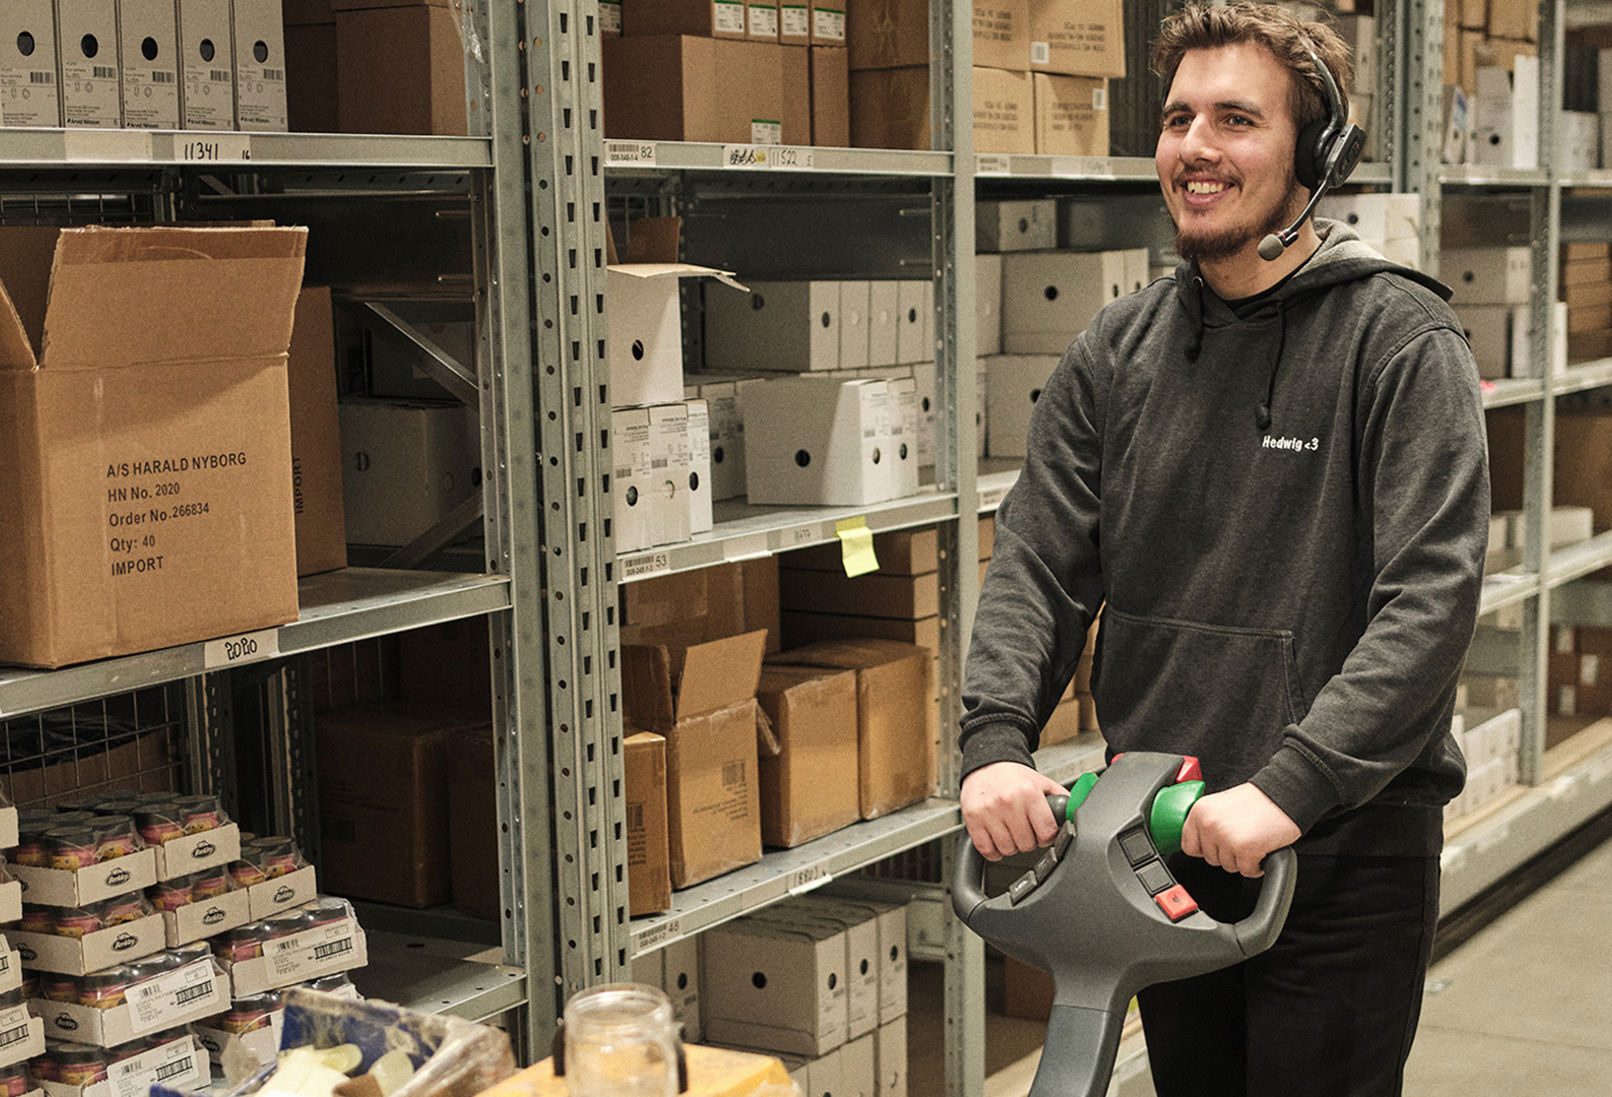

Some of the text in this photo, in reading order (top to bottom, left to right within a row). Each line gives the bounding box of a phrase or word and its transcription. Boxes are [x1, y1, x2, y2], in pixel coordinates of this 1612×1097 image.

[185, 142, 218, 160] 11341
[641, 146, 653, 158] 82
[107, 452, 247, 478] A/S HARALD NYBORG
[108, 482, 180, 502] HN No. 2020
[292, 456, 304, 514] IMPORT
[109, 512, 147, 527] Order
[110, 535, 156, 554] Qty: 40
[111, 555, 164, 576] IMPORT
[656, 554, 667, 567] 53
[225, 637, 257, 661] 2020
